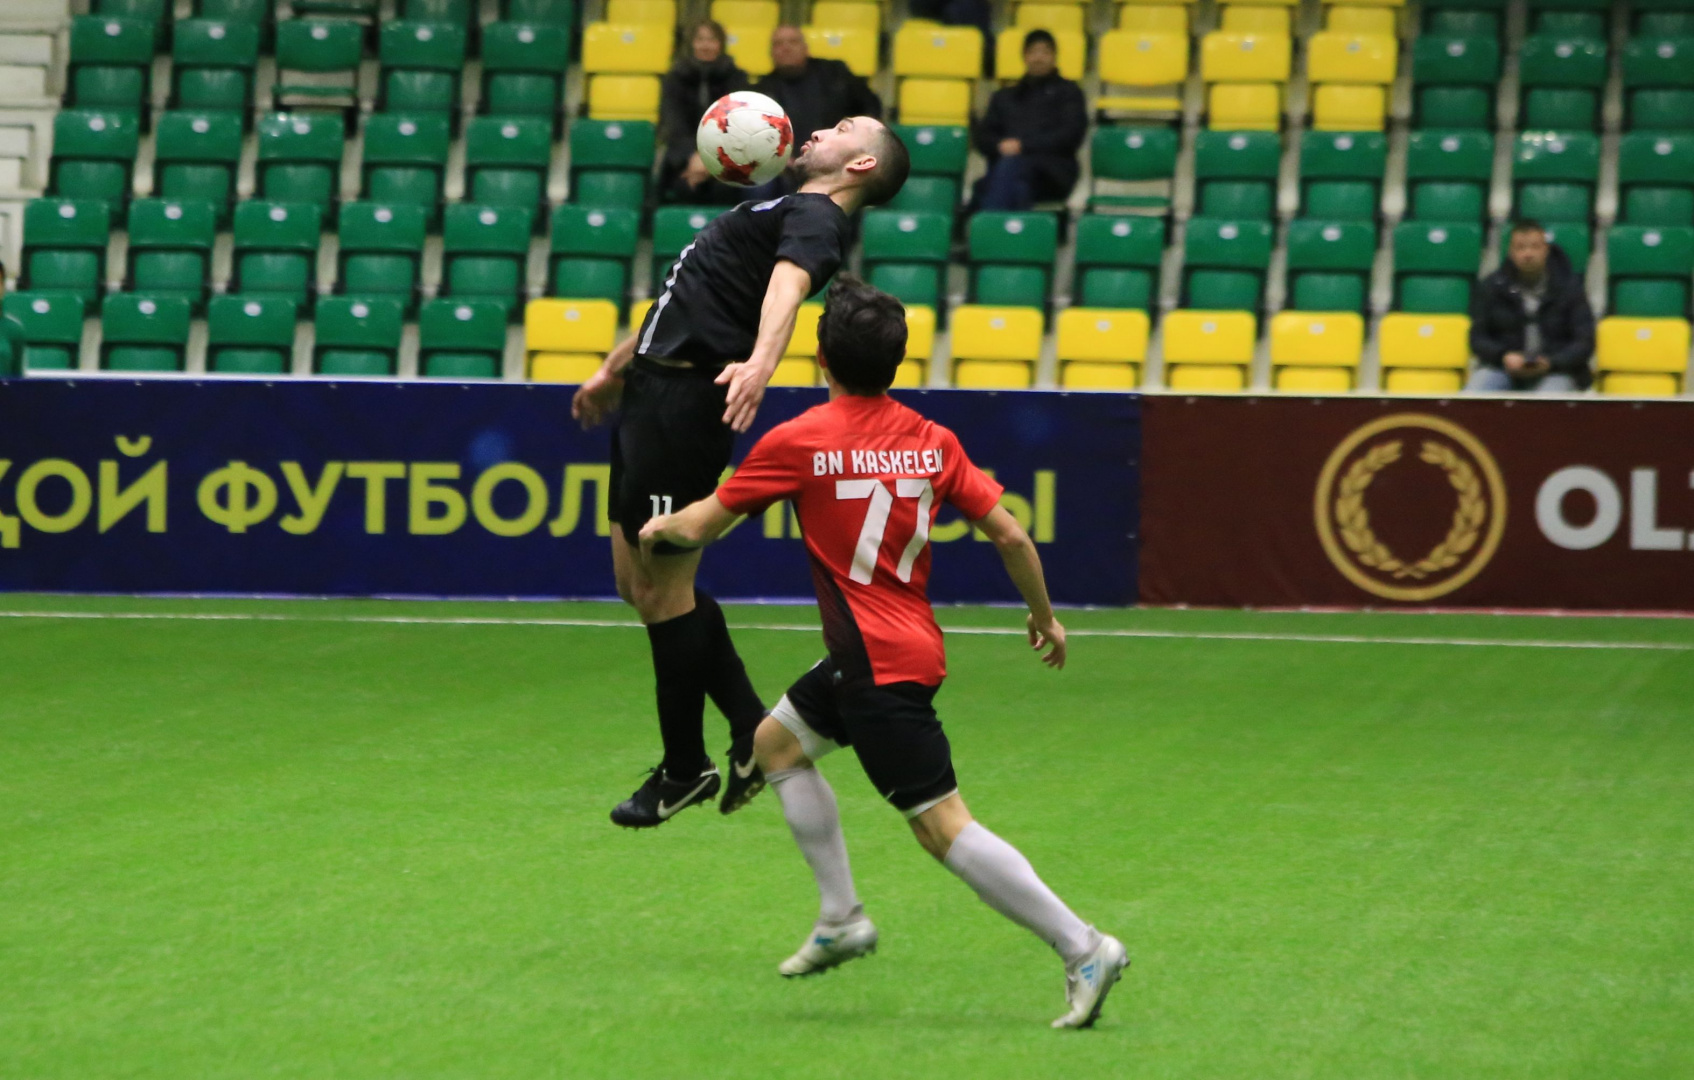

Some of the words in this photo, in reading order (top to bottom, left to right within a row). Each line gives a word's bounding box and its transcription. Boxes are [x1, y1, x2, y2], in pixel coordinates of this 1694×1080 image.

[198, 460, 611, 537] ФУТБОЛ
[813, 450, 844, 476] BN
[851, 448, 943, 475] KASKELEN
[649, 494, 673, 519] 11
[835, 478, 934, 586] 77
[1534, 464, 1694, 551] OL
